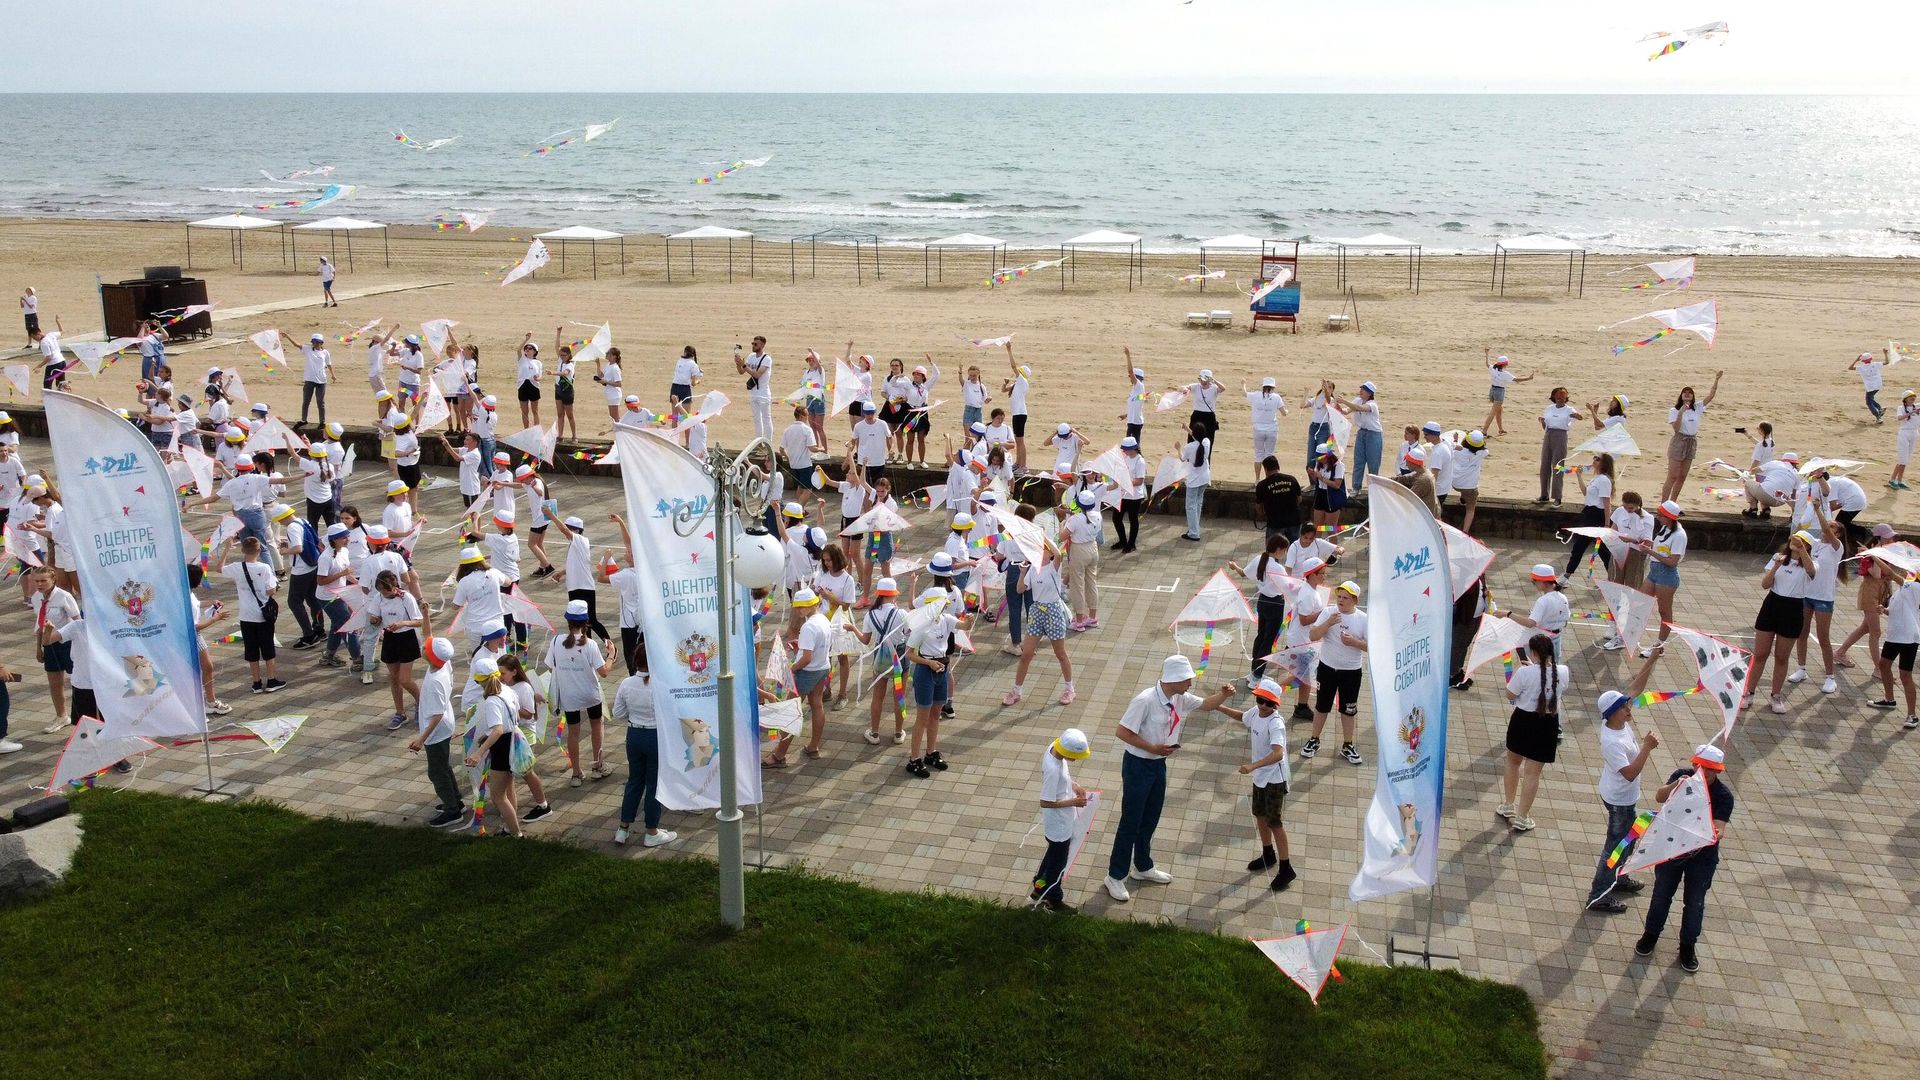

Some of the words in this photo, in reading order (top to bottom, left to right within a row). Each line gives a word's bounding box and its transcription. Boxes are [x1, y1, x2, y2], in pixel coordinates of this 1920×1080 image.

[94, 534, 102, 549] В
[104, 526, 154, 548] ЦЕНТРЕ
[99, 542, 157, 568] СОБЫТИЙ
[662, 581, 669, 598] В
[1395, 652, 1401, 670] В
[1402, 636, 1430, 667] ЦЕНТРЕ
